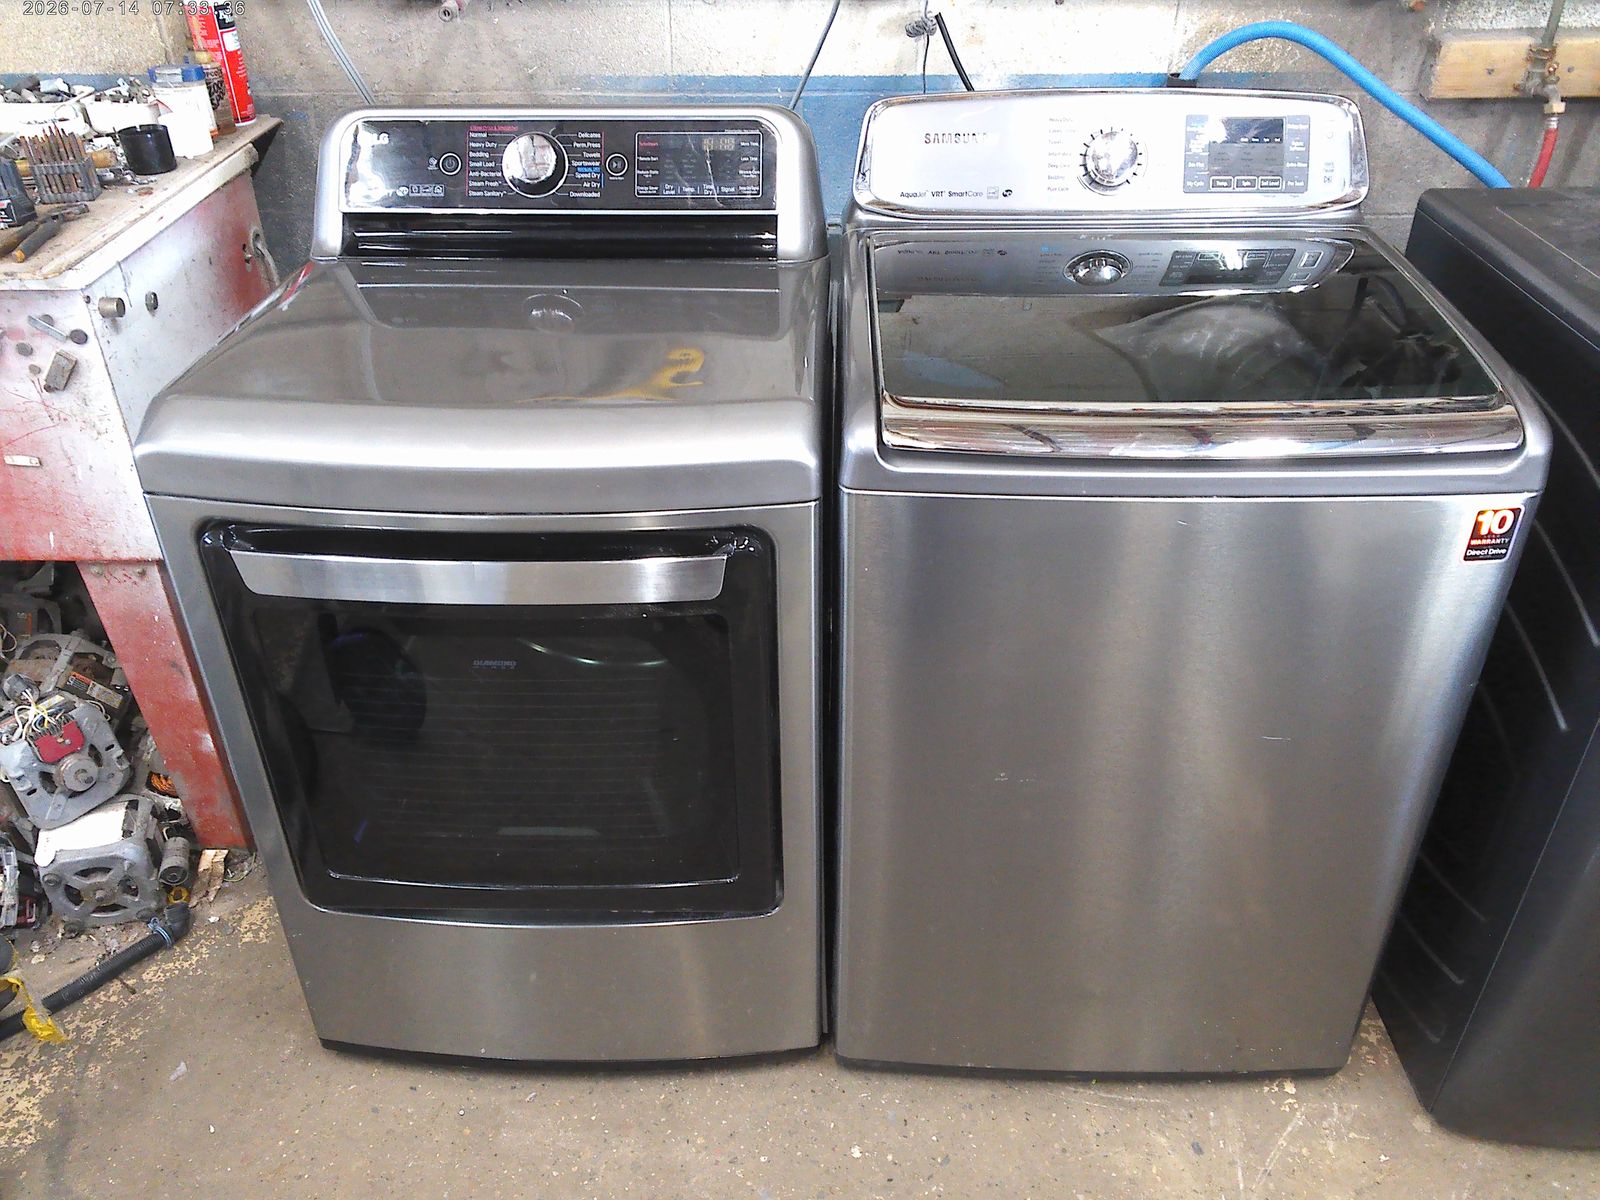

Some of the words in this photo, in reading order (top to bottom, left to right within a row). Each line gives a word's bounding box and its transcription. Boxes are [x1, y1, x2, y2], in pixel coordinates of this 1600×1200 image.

[575, 172, 591, 180] Speed
[591, 172, 601, 180] Dry
[948, 190, 983, 198] SmartCare
[1477, 509, 1515, 536] 10
[1470, 538, 1510, 546] WARRANTY
